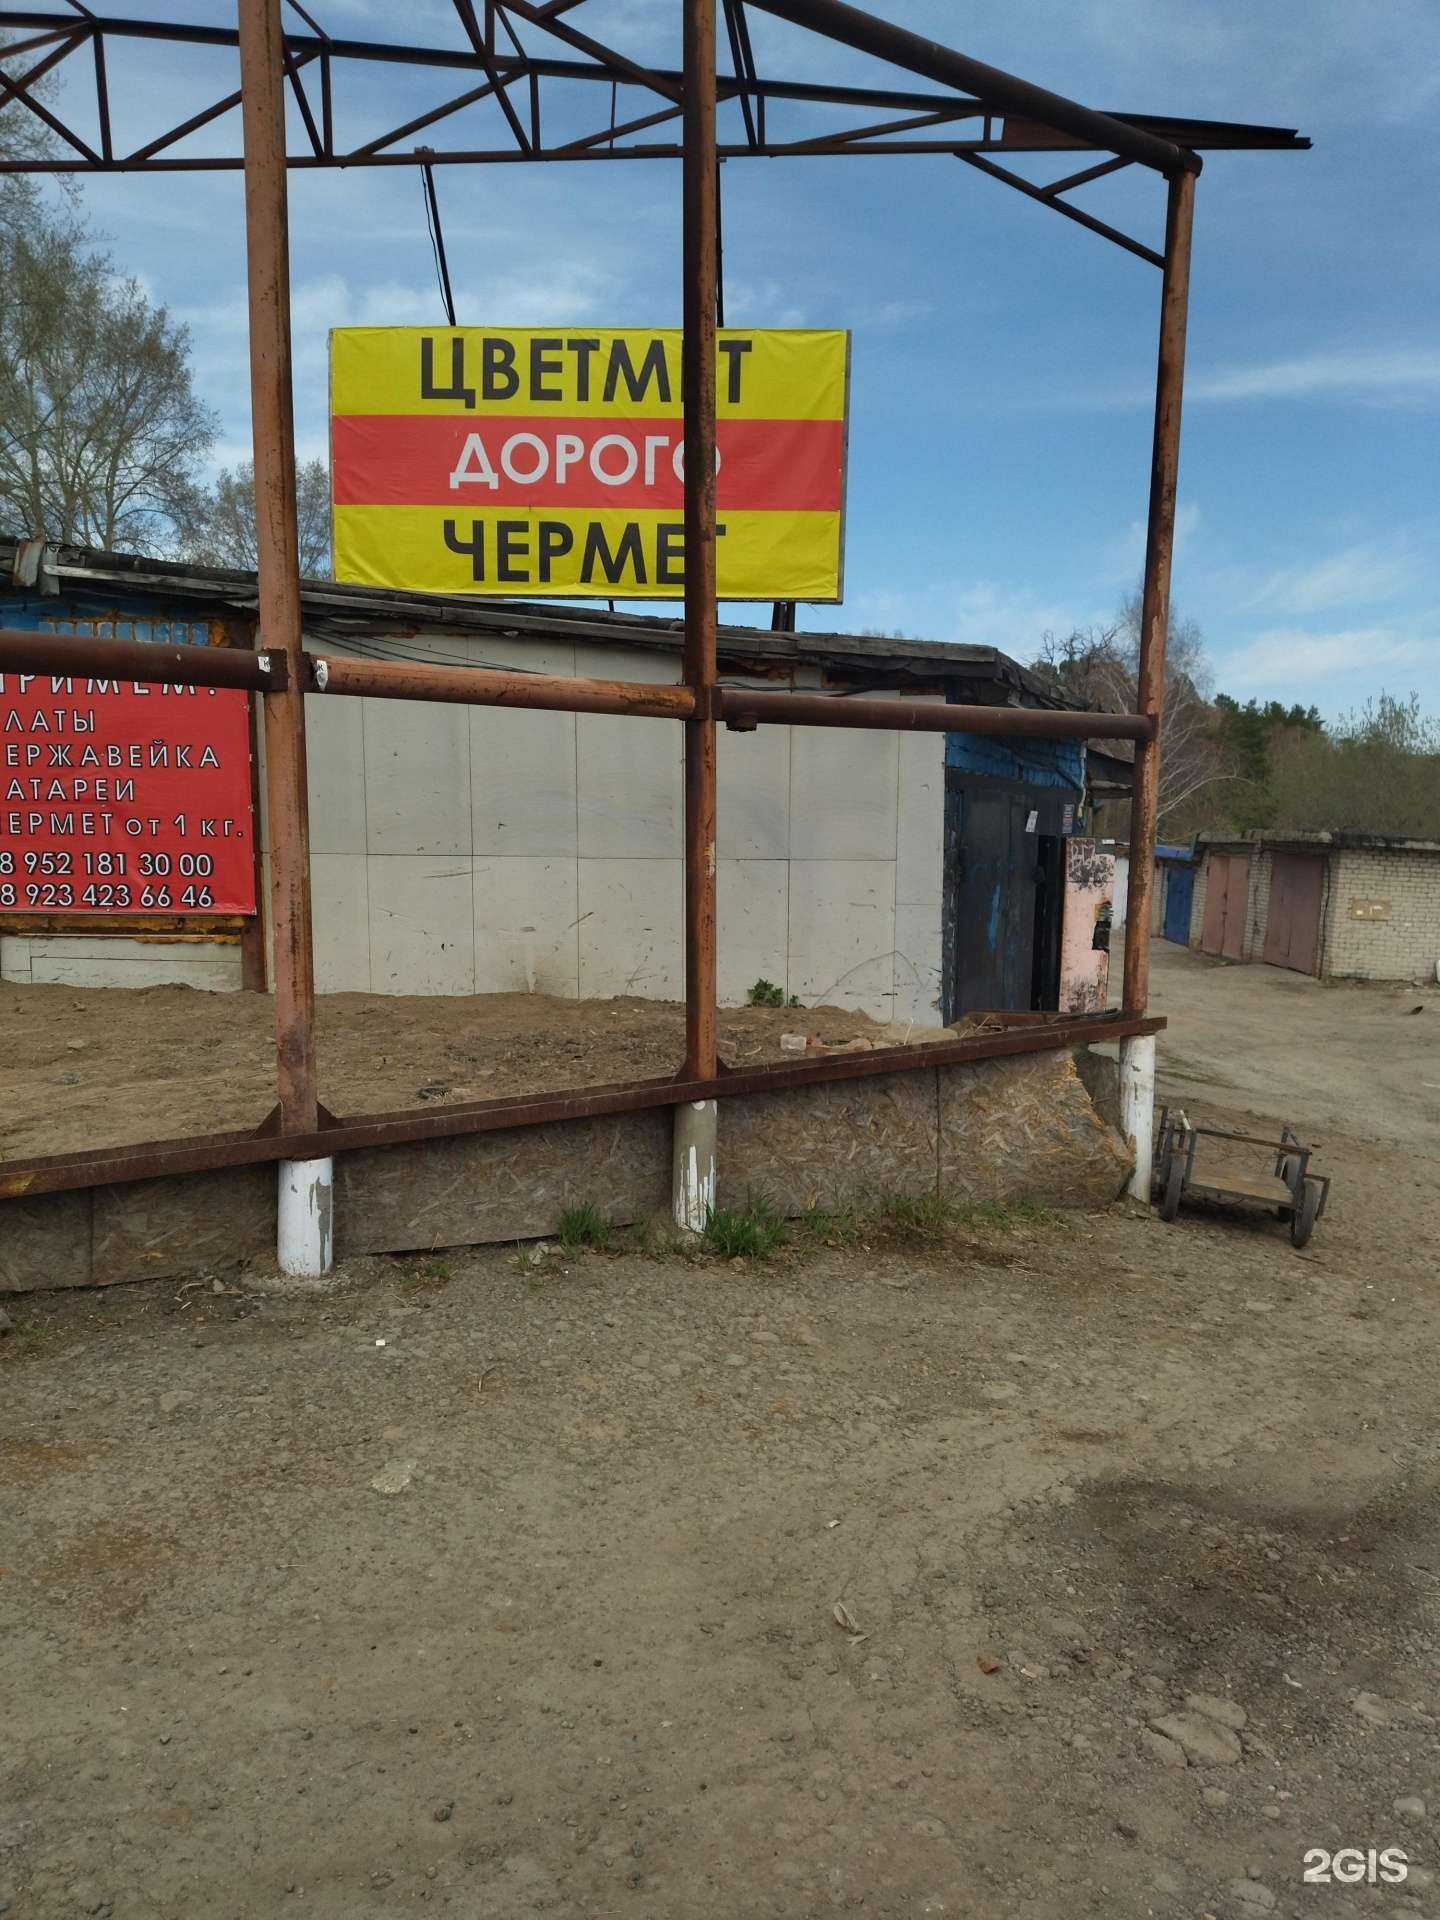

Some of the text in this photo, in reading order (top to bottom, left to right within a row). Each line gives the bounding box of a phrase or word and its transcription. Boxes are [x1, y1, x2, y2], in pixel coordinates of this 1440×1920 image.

[420, 337, 753, 409] ЦВЕТМТ
[443, 519, 727, 585] ЧЕРМЕ
[125, 819, 160, 836] от
[173, 814, 186, 836] 1
[0, 852, 213, 877] 8 952 181 30 00
[1, 883, 214, 908] 8 923 423 66 46
